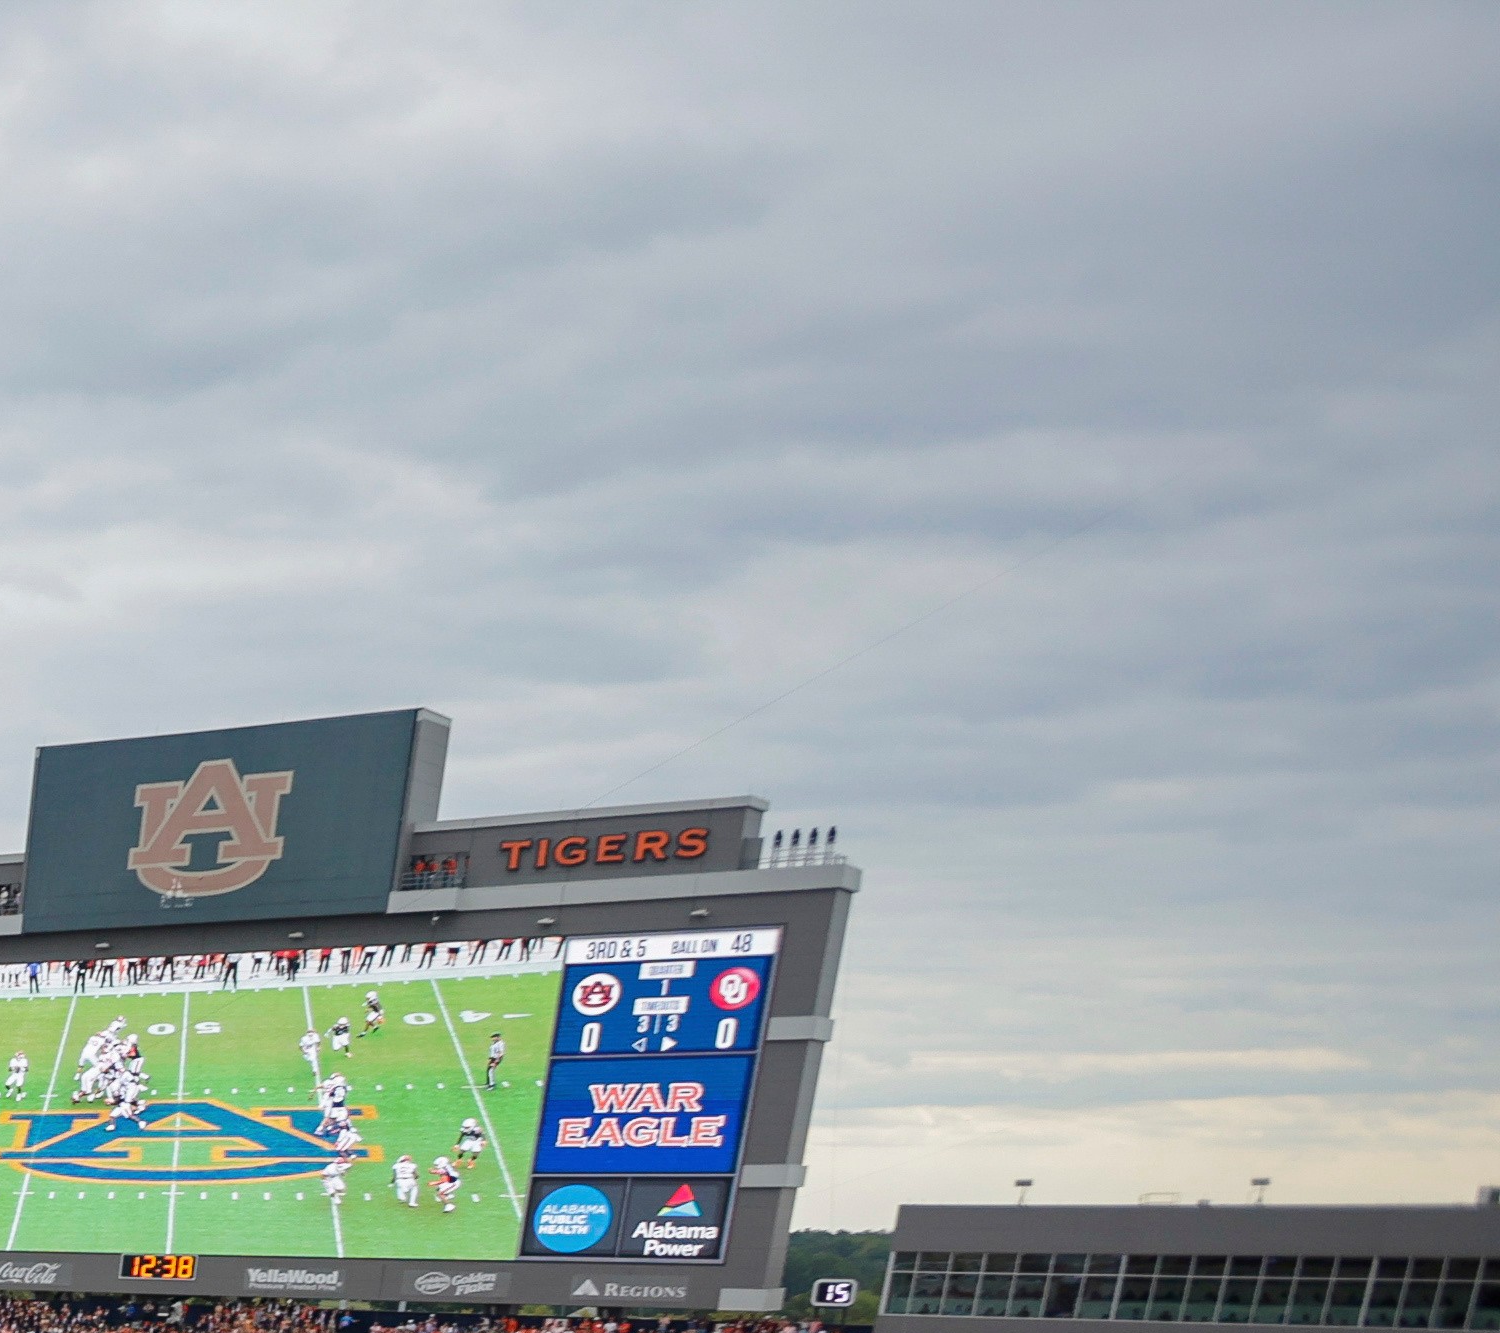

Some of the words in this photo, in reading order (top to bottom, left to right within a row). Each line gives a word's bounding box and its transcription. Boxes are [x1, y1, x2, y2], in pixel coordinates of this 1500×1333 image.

[500, 828, 710, 870] TIGERS
[586, 940, 616, 959] 3RD
[620, 940, 632, 958] &
[636, 939, 647, 957] 5
[671, 940, 698, 954] BALL
[700, 939, 719, 953] ON
[731, 934, 753, 953] 48
[637, 1016, 650, 1034] 3
[666, 1014, 680, 1032] 3
[580, 1022, 602, 1053] 0
[715, 1017, 739, 1049] 0
[588, 1082, 705, 1113] WAR
[555, 1115, 727, 1147] EAGLE
[543, 1204, 607, 1214] ALABAMA
[540, 1215, 587, 1224] PUBLIC
[538, 1225, 590, 1235] HEALTH
[632, 1222, 718, 1239] Alabama
[643, 1240, 703, 1257] Power
[132, 1255, 193, 1277] 12:38
[452, 1273, 498, 1286] Golden
[455, 1282, 497, 1295] Flake
[826, 1283, 851, 1303] 15
